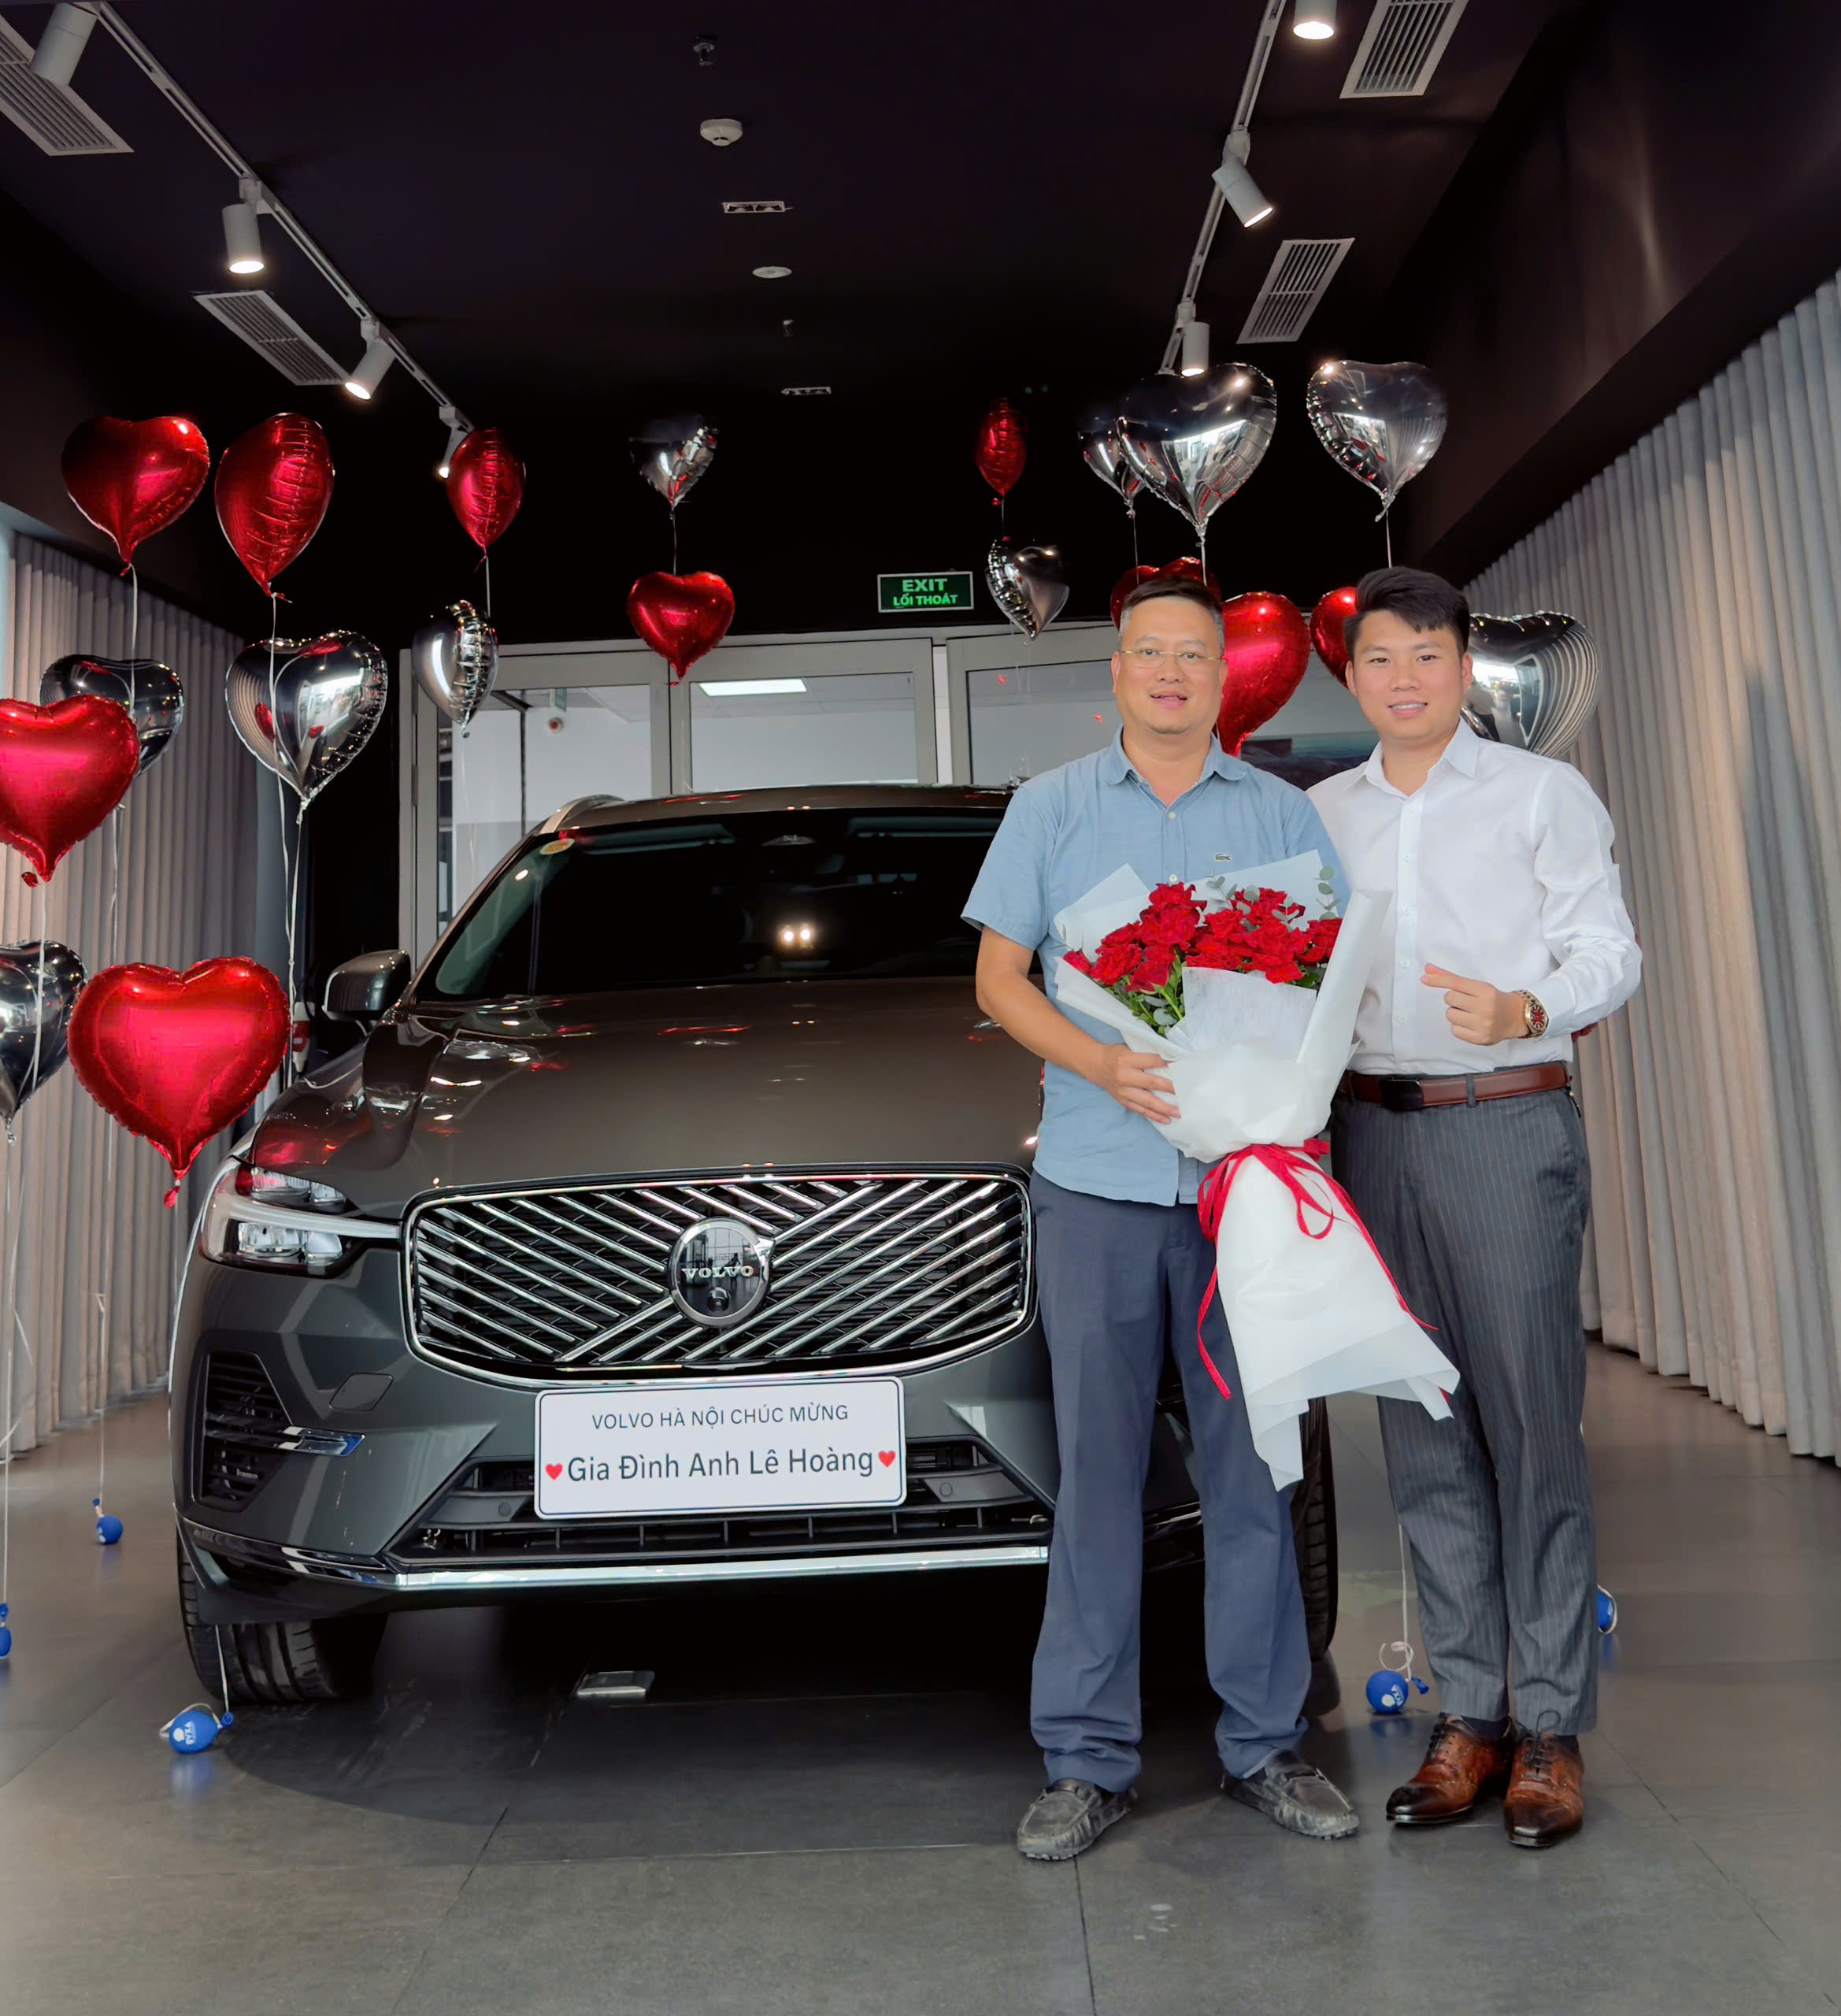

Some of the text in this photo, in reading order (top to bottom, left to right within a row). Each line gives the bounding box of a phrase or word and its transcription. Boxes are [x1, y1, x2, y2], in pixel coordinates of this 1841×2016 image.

[902, 578, 947, 592] EXIT
[893, 593, 958, 606] LỐI THOÁT
[681, 1266, 754, 1279] VOLVO
[592, 1402, 848, 1429] VOLVO HÀ NỘI CHÚC MỪNG
[568, 1447, 872, 1481] Gia Đình Anh Lê Hoàng
